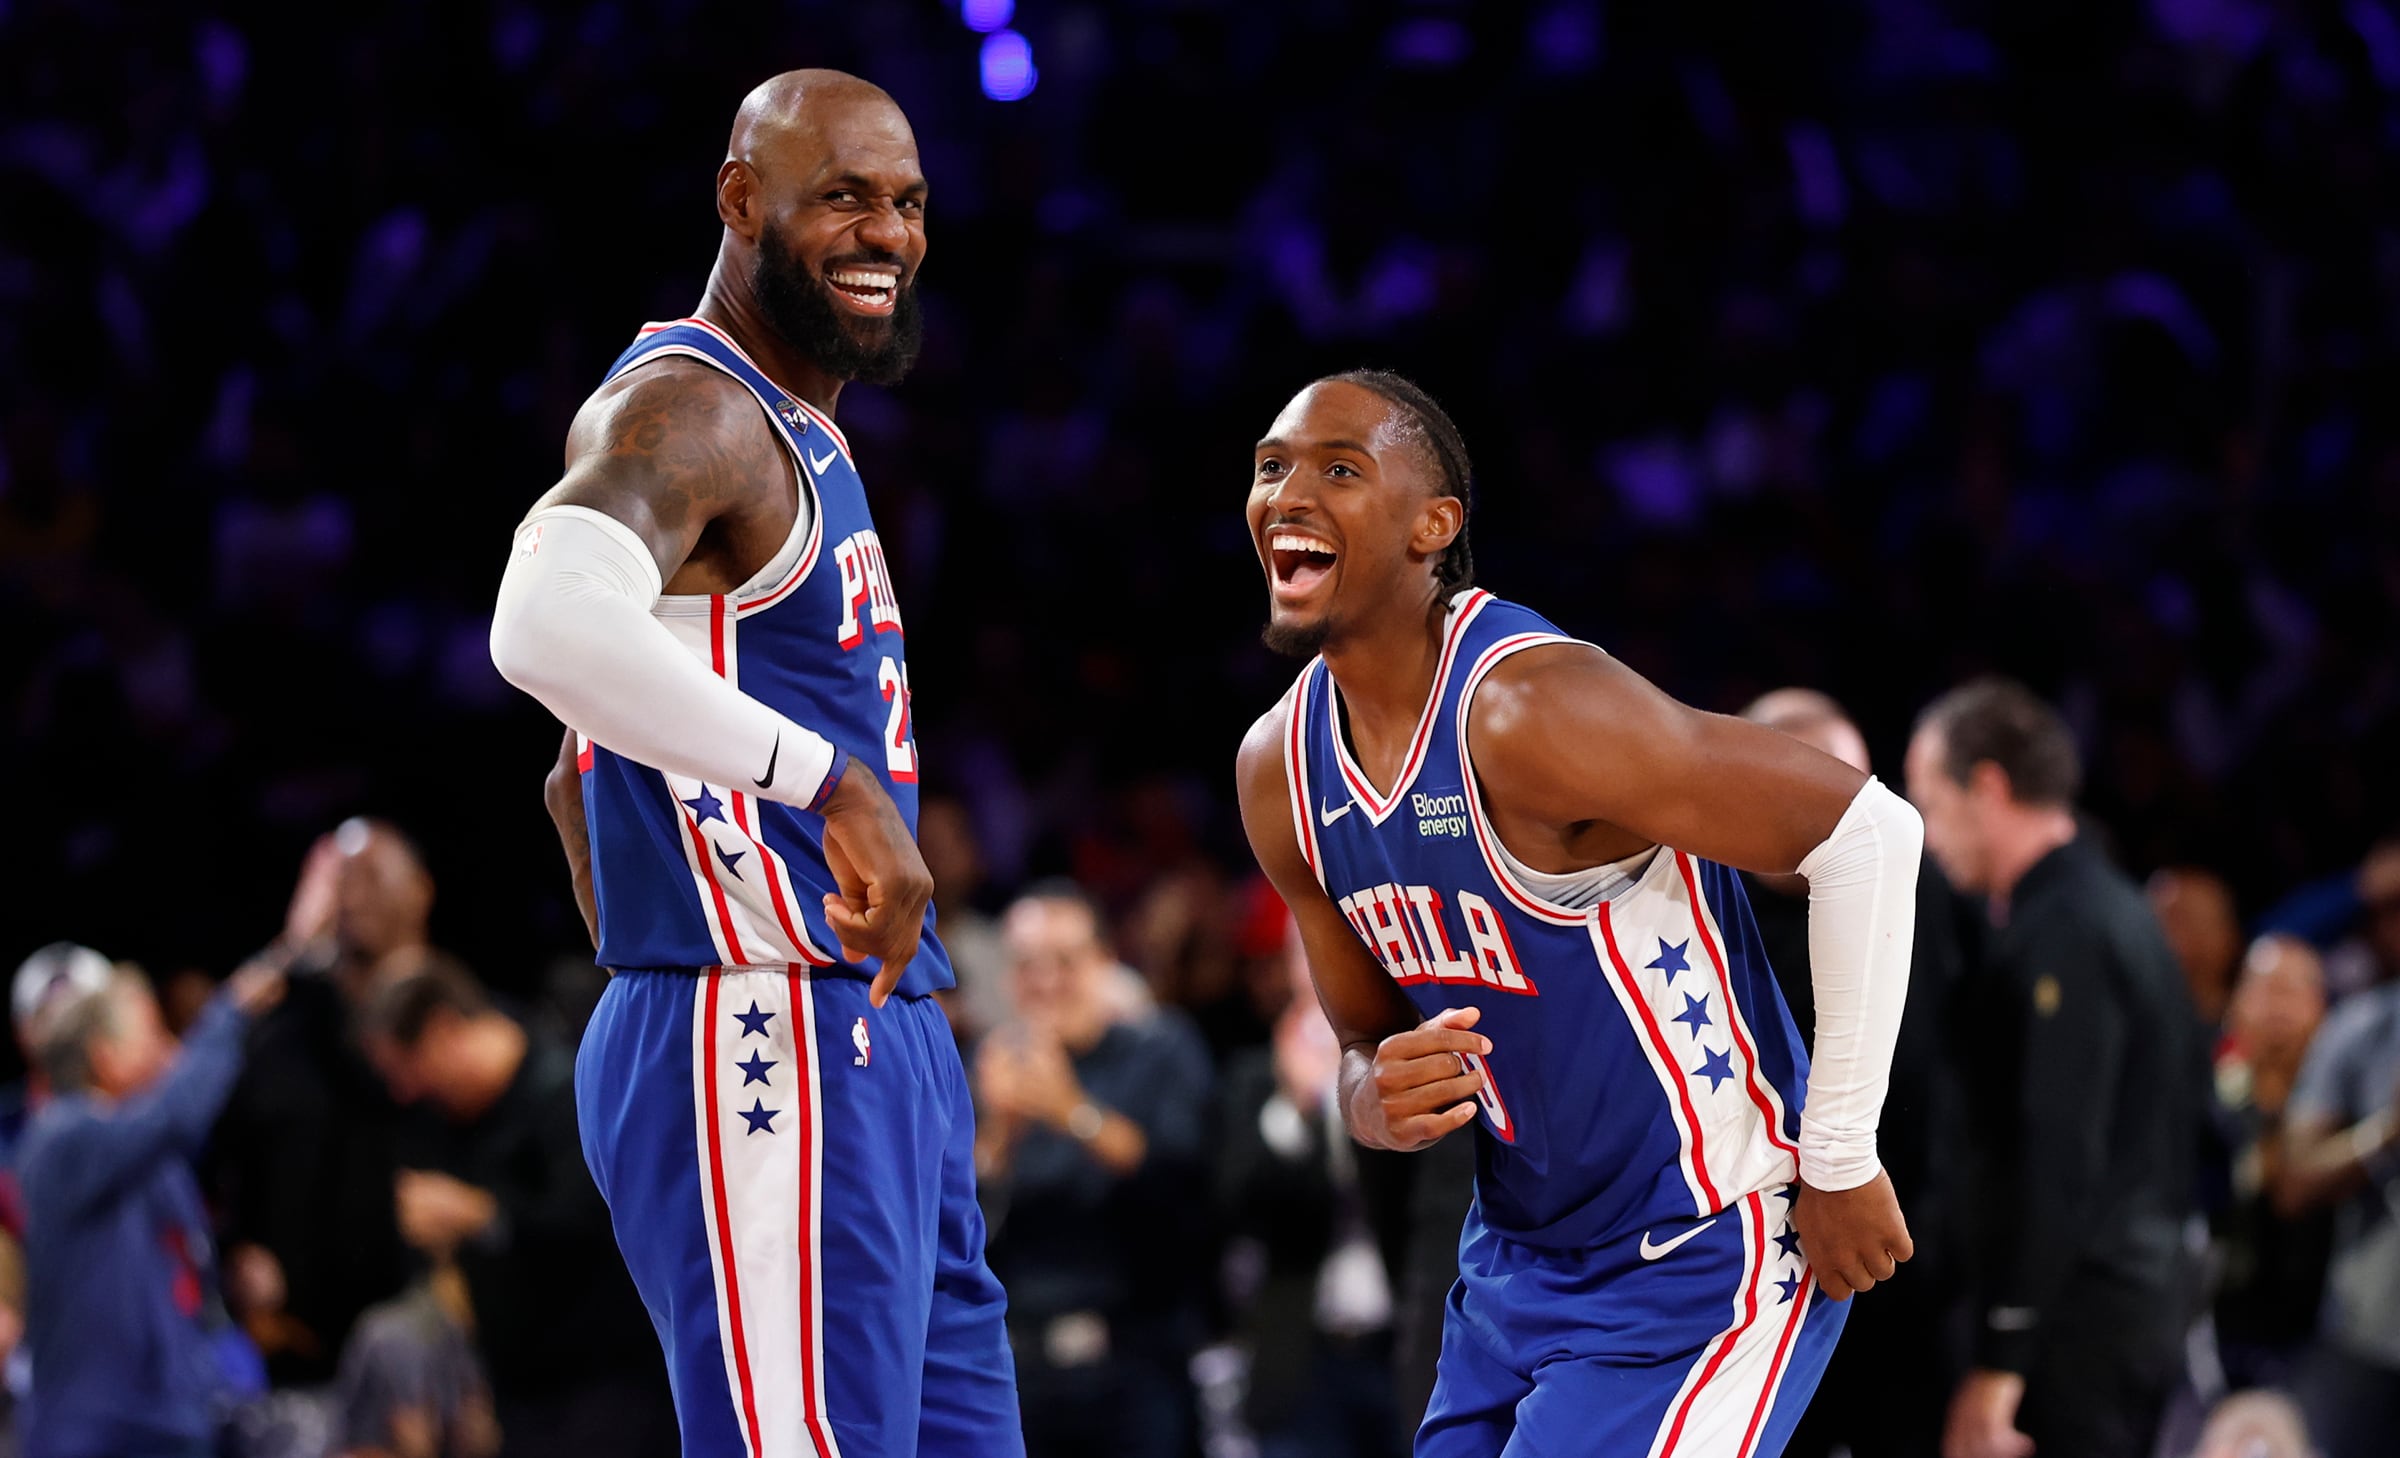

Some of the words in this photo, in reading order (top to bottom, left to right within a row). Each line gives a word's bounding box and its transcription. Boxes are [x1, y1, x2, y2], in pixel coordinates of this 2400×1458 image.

[878, 656, 919, 784] 2
[1411, 792, 1465, 817] Bloom
[1419, 815, 1467, 838] energy
